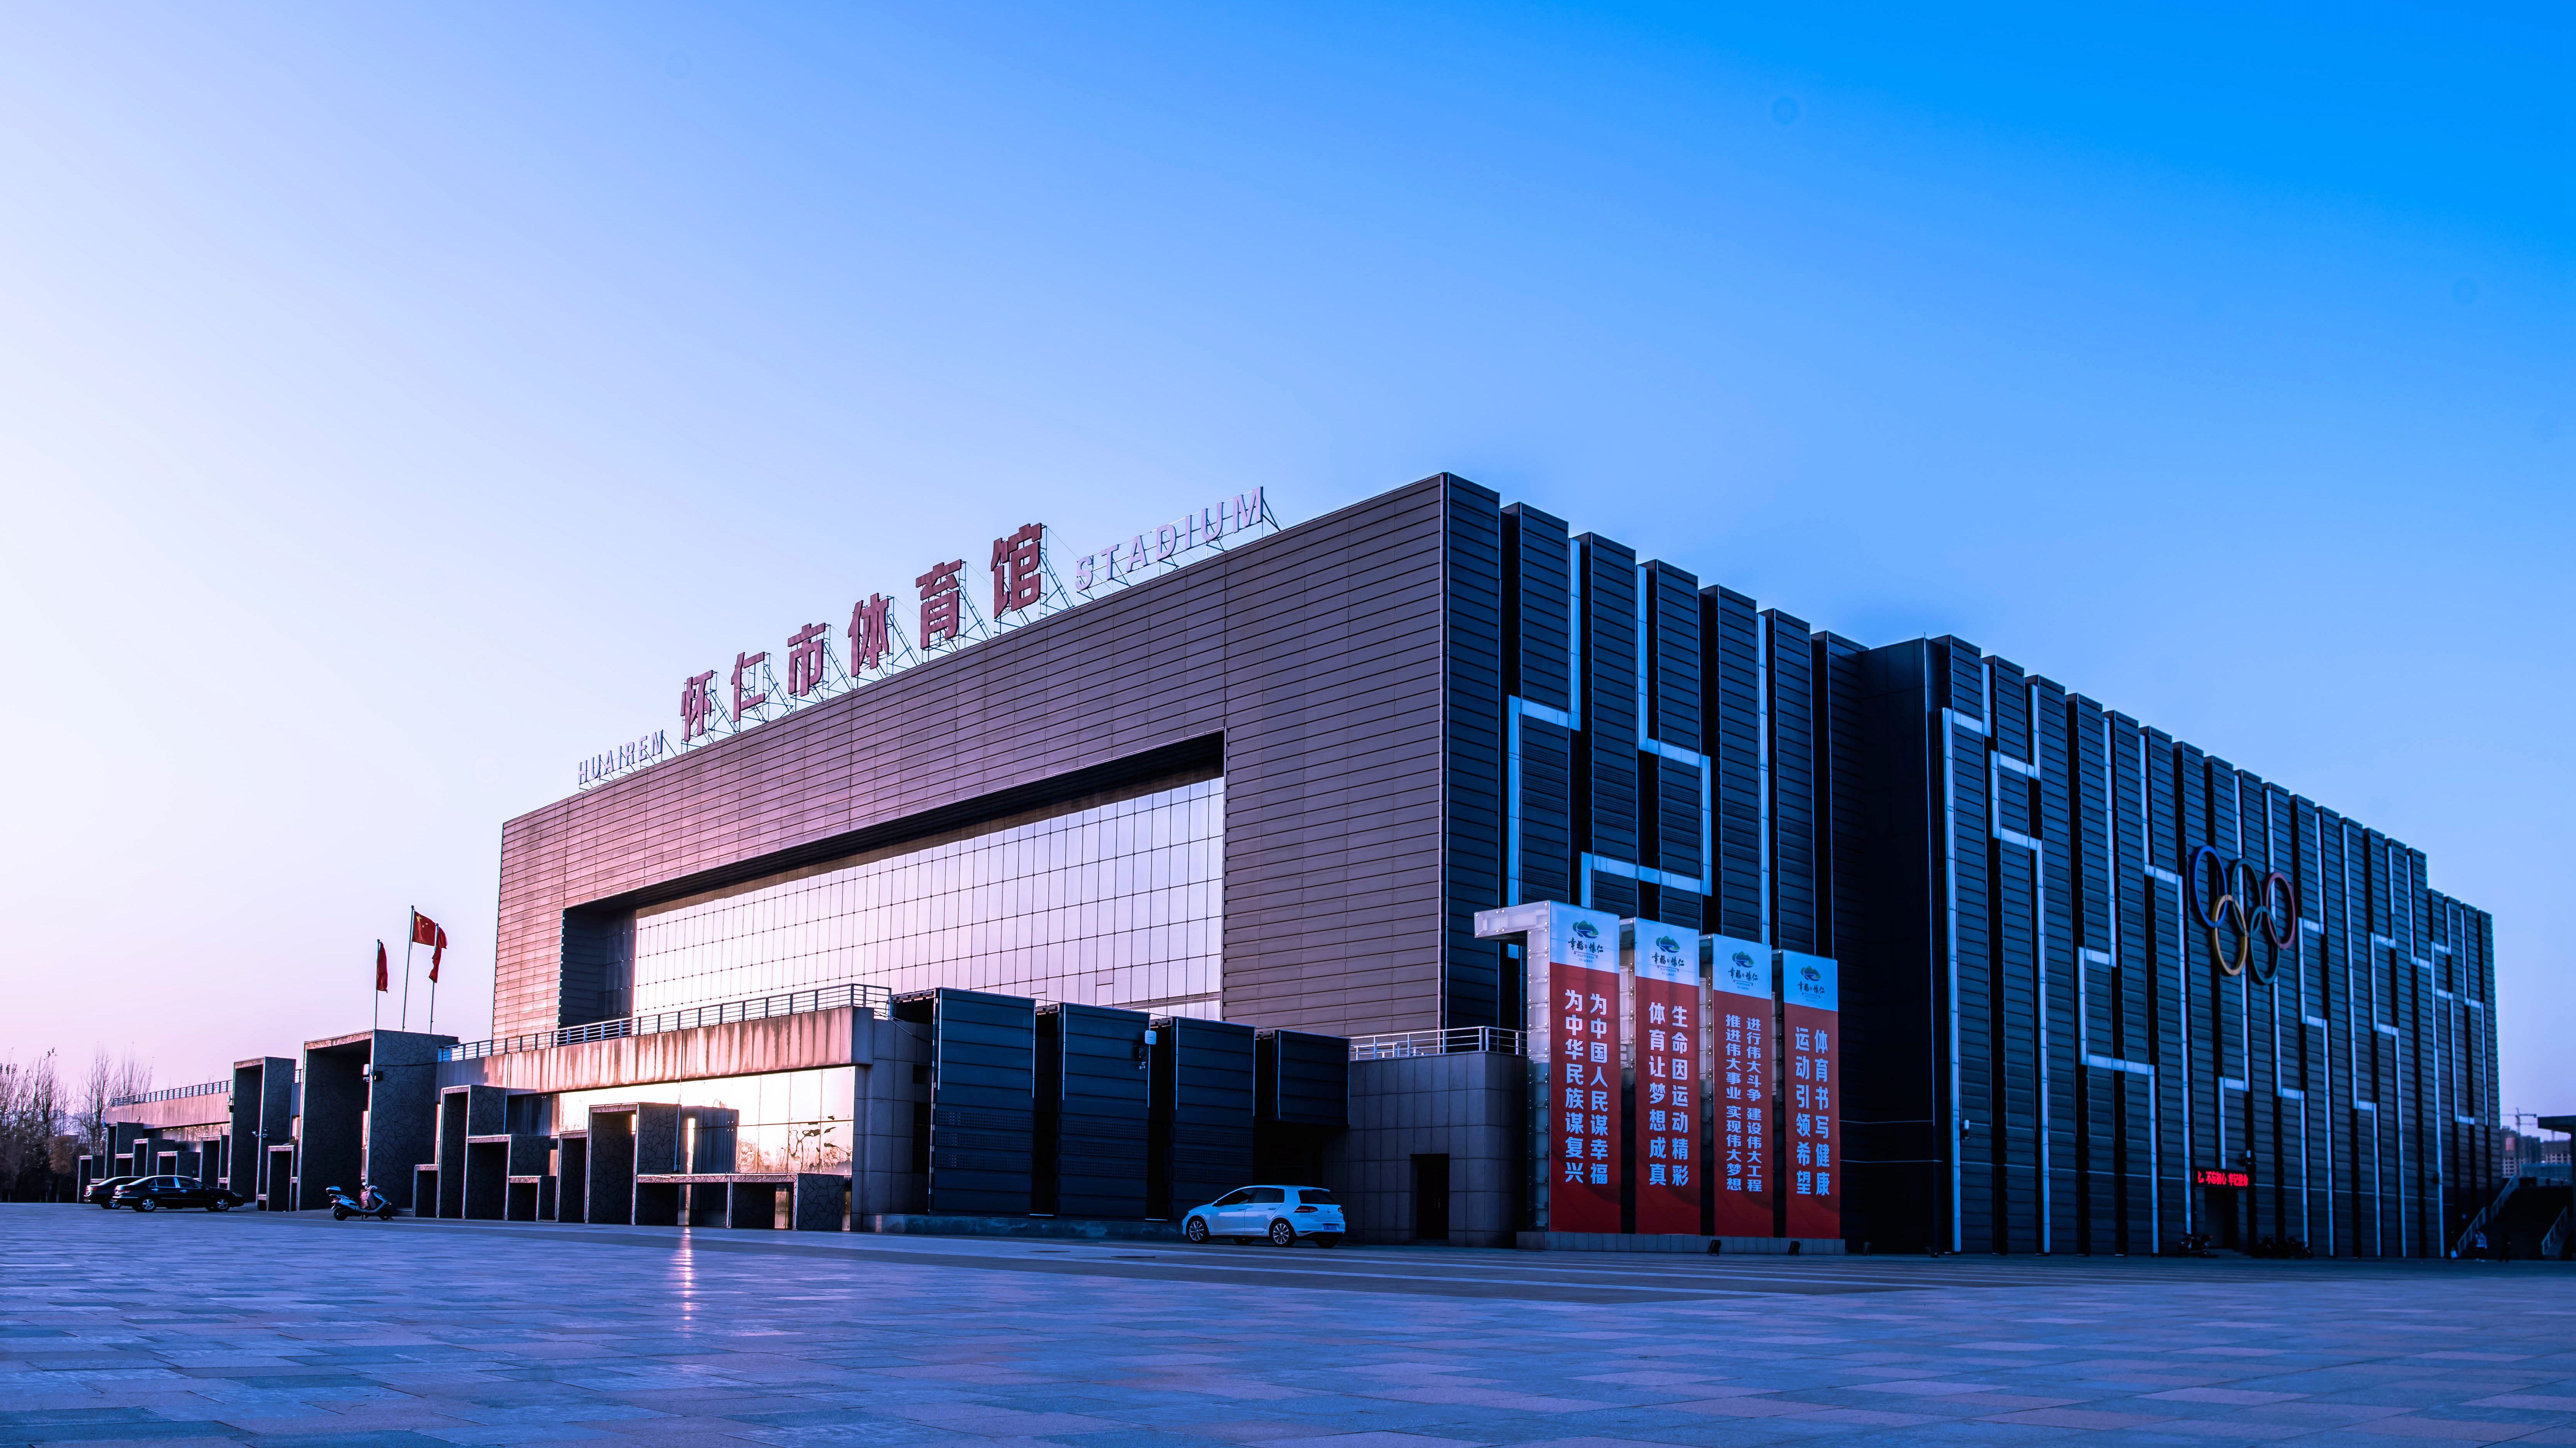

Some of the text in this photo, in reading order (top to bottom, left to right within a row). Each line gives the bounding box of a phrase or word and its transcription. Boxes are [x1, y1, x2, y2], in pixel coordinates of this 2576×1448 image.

[1075, 486, 1263, 590] STADIUM
[680, 522, 1042, 742] 怀仁市体育馆
[578, 730, 663, 784] HUAIREN
[1565, 989, 1584, 1184] 为中华民族谋复兴
[1590, 993, 1608, 1184] 为中国人民谋幸福
[1648, 1002, 1666, 1185] 体育让梦想成真
[1672, 1005, 1689, 1186] 生命因运动精彩
[1725, 1014, 1742, 1191] 推进伟大事业 实现伟大梦想
[1746, 1017, 1762, 1192] 进行伟大斗争 建设伟大工程
[1795, 1026, 1811, 1194] 运动引领希望
[1814, 1029, 1830, 1196] 体育书写健康
